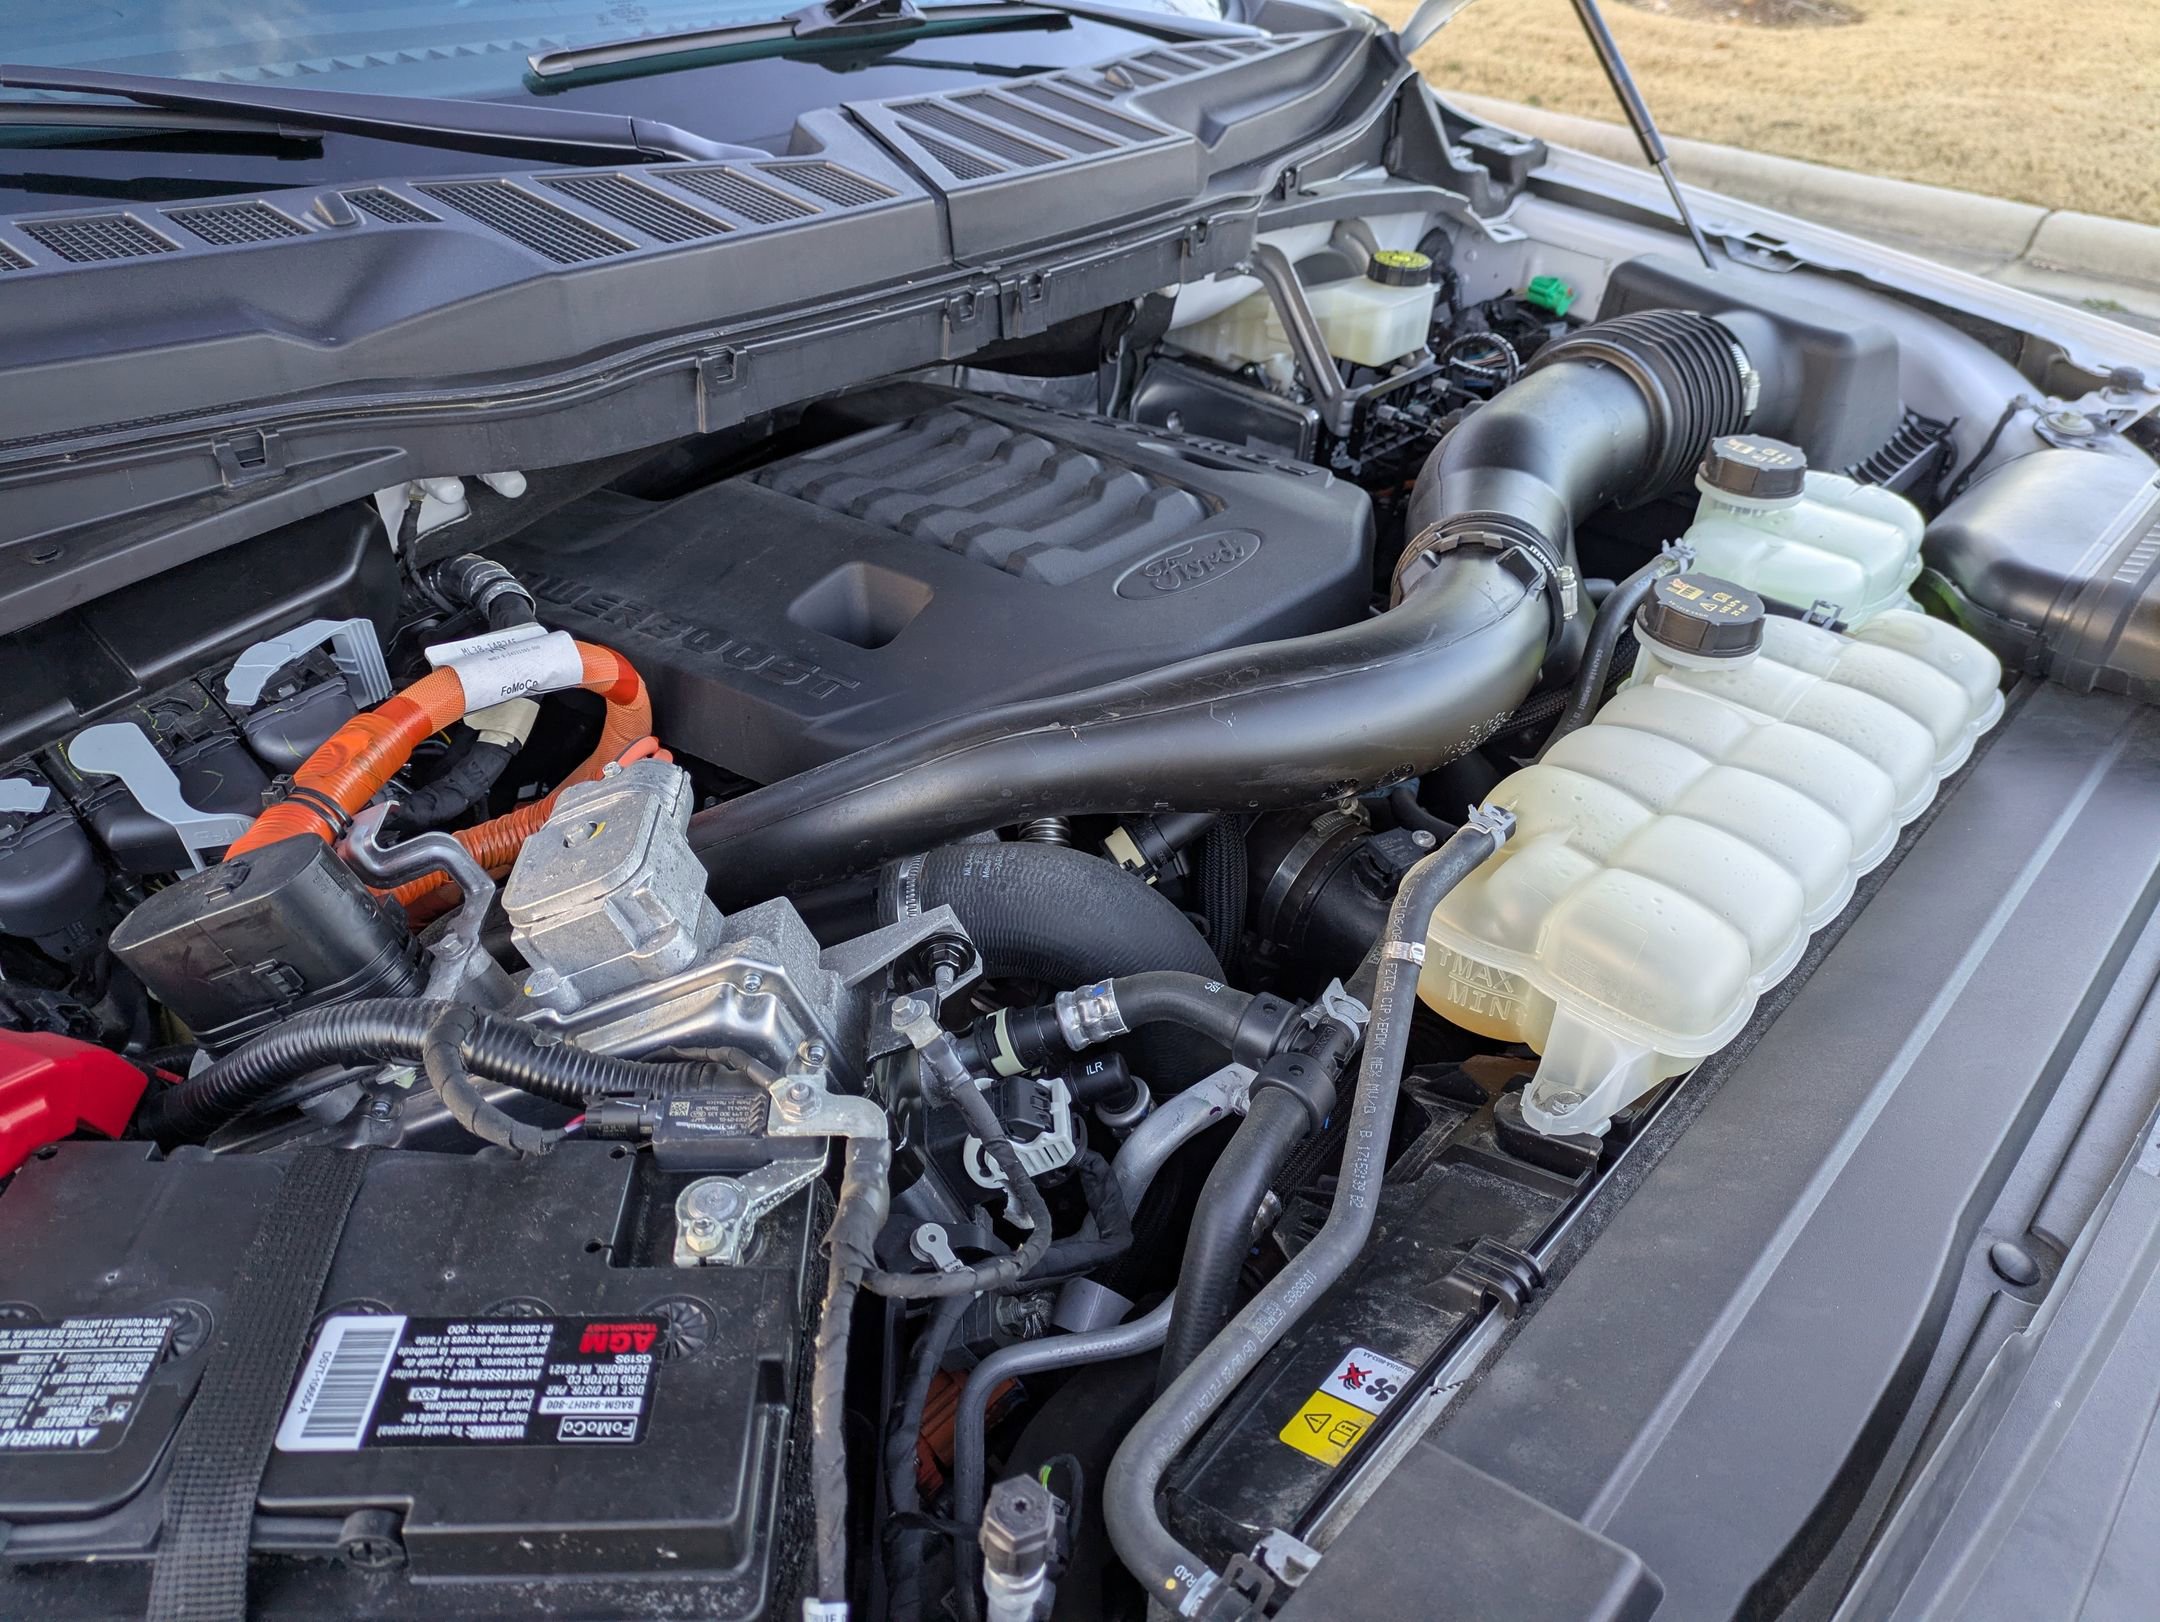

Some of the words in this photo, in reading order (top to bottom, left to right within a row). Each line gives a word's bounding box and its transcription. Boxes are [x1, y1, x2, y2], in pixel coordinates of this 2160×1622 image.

[1141, 538, 1248, 592] Ford
[501, 679, 538, 696] FoMoCo
[1453, 952, 1514, 993] MAX
[1448, 981, 1512, 1020] MIN
[1086, 1061, 1104, 1076] ILR
[102, 1319, 113, 1328] LA
[113, 1318, 144, 1327] OUVRIR
[144, 1318, 160, 1326] PAS
[161, 1318, 171, 1326] NE
[98, 1329, 108, 1337] LA
[109, 1328, 120, 1337] DE
[121, 1328, 142, 1337] HORS
[143, 1328, 167, 1337] TENIR
[447, 1325, 469, 1335] 800
[476, 1325, 509, 1334] volants
[543, 1325, 553, 1334] de
[585, 1323, 658, 1333] TECHNOLOGY
[50, 1330, 66, 1338] DES
[65, 1339, 74, 1348] OF
[75, 1338, 100, 1347] REACH
[101, 1338, 114, 1347] THE
[116, 1338, 126, 1346] OF
[128, 1338, 143, 1346] OUT
[143, 1337, 162, 1346] KEEP
[452, 1336, 487, 1345] secours
[539, 1335, 550, 1345] de
[579, 1333, 656, 1353] AGM
[439, 1347, 449, 1357] la
[402, 1358, 416, 1368] du
[418, 1356, 445, 1368] guide
[445, 1358, 455, 1368] le
[457, 1358, 476, 1368] Voir
[479, 1357, 526, 1368] blessures.
[527, 1357, 544, 1368] des
[615, 1354, 652, 1363] G519S
[420, 1369, 442, 1378] Pour
[548, 1365, 577, 1374] 48121
[579, 1365, 592, 1374] MI
[594, 1363, 649, 1374] DEARBORN,
[50, 1374, 66, 1384] LES
[67, 1373, 87, 1383] YEUX
[88, 1373, 102, 1383] LES
[449, 1369, 541, 1380] AVERTISSEMENT
[566, 1375, 581, 1384] CO.
[583, 1375, 618, 1384] MOTOR
[620, 1375, 647, 1384] FORD
[413, 1389, 436, 1399] 800
[440, 1388, 468, 1399] amps
[470, 1388, 511, 1400] cranking
[512, 1389, 535, 1400] Cold
[546, 1385, 567, 1395] PAR
[571, 1385, 602, 1395] DISTR.
[604, 1385, 618, 1395] BY
[621, 1385, 645, 1395] DIST.
[81, 1395, 108, 1406] GASES
[507, 1400, 532, 1411] jump
[422, 1402, 481, 1411] instructions.
[482, 1402, 505, 1411] start
[46, 1407, 93, 1417] EXPLOSIVE
[499, 1411, 528, 1423] injury
[401, 1414, 417, 1423] for
[418, 1412, 446, 1423] guide
[447, 1413, 478, 1422] owner
[480, 1413, 498, 1422] see
[33, 1418, 56, 1428] EYES
[376, 1424, 421, 1437] personal
[422, 1425, 450, 1436] avoid
[452, 1425, 464, 1437] To
[465, 1425, 525, 1438] WARNING:
[563, 1421, 634, 1436] FoMoCo
[1174, 1565, 1198, 1588] RAD
